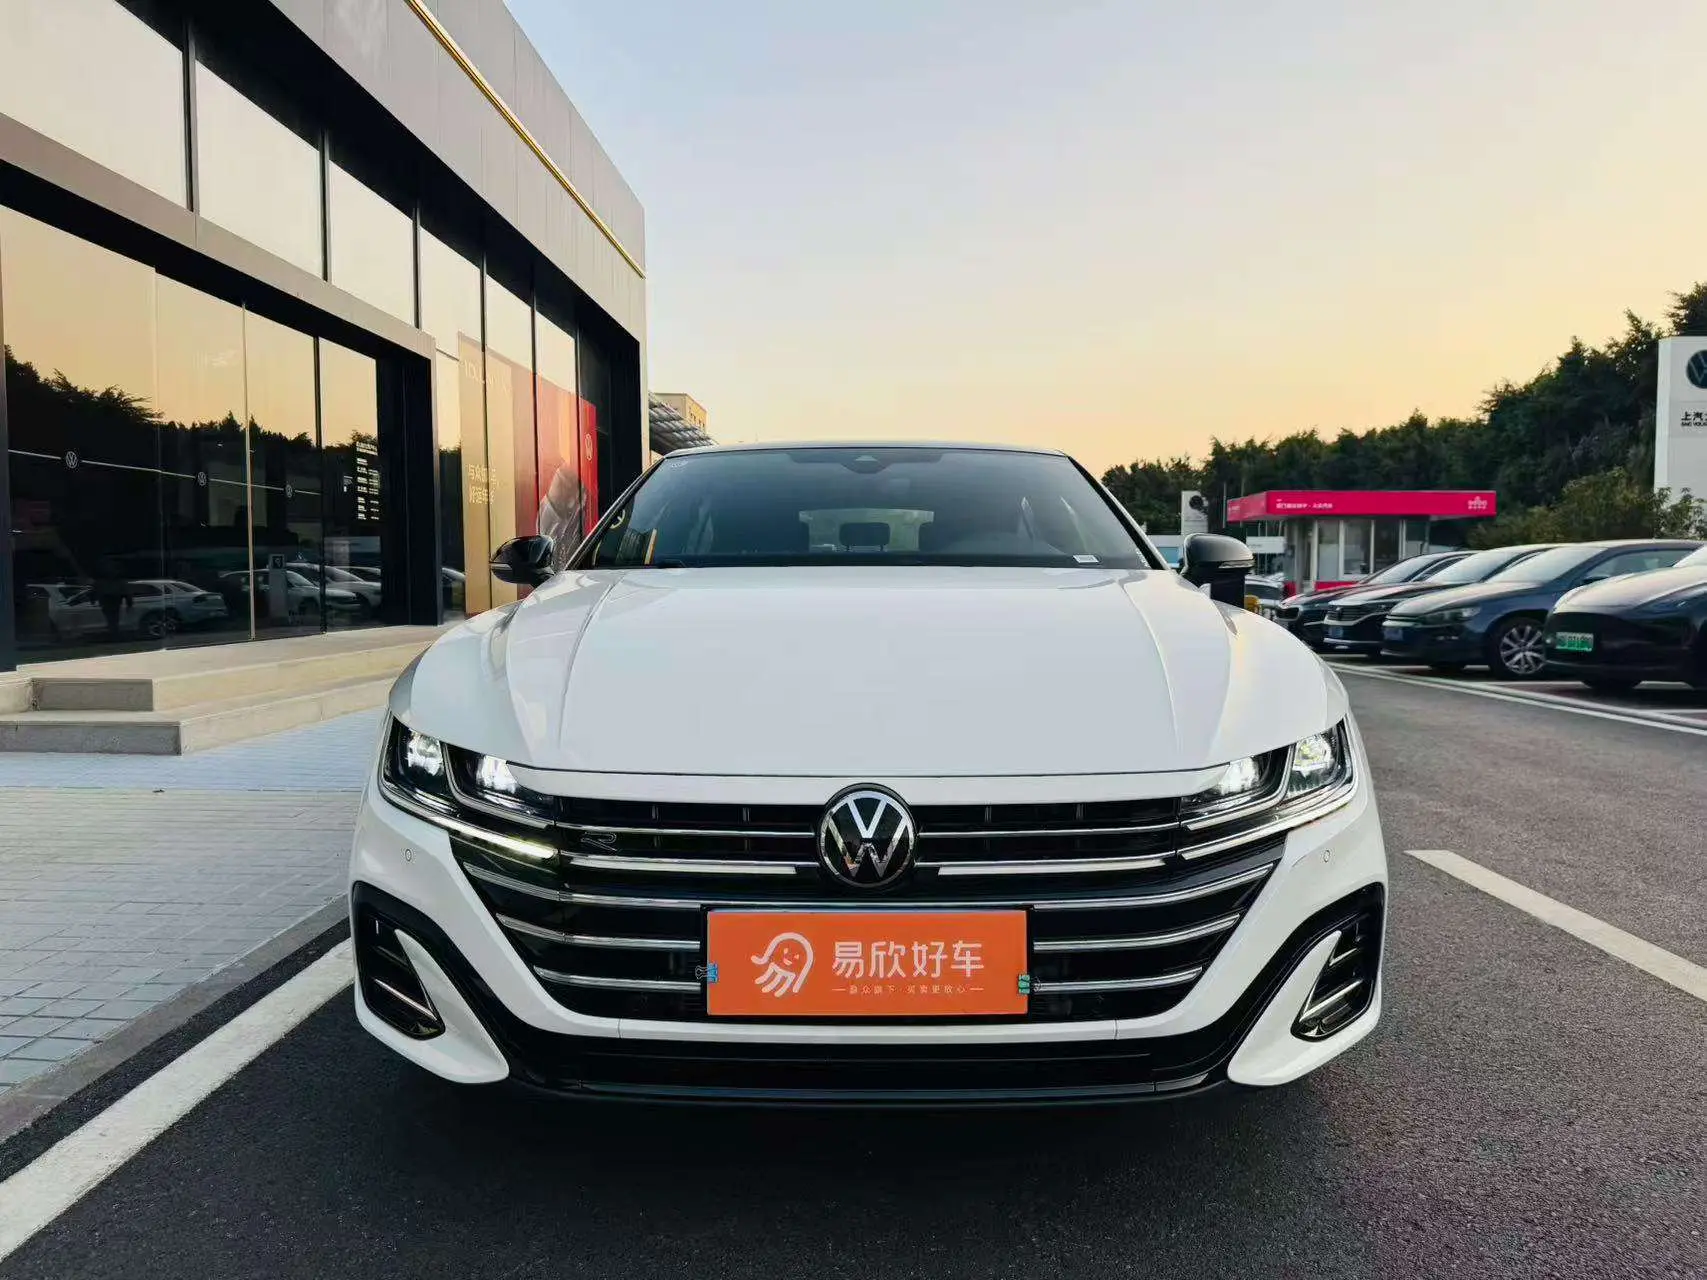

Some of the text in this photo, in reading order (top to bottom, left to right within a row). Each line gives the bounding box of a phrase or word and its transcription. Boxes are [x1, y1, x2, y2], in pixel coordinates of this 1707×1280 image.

[1681, 411, 1707, 421] 上汽
[819, 787, 915, 888] VW
[832, 941, 984, 978] 易欣好车
